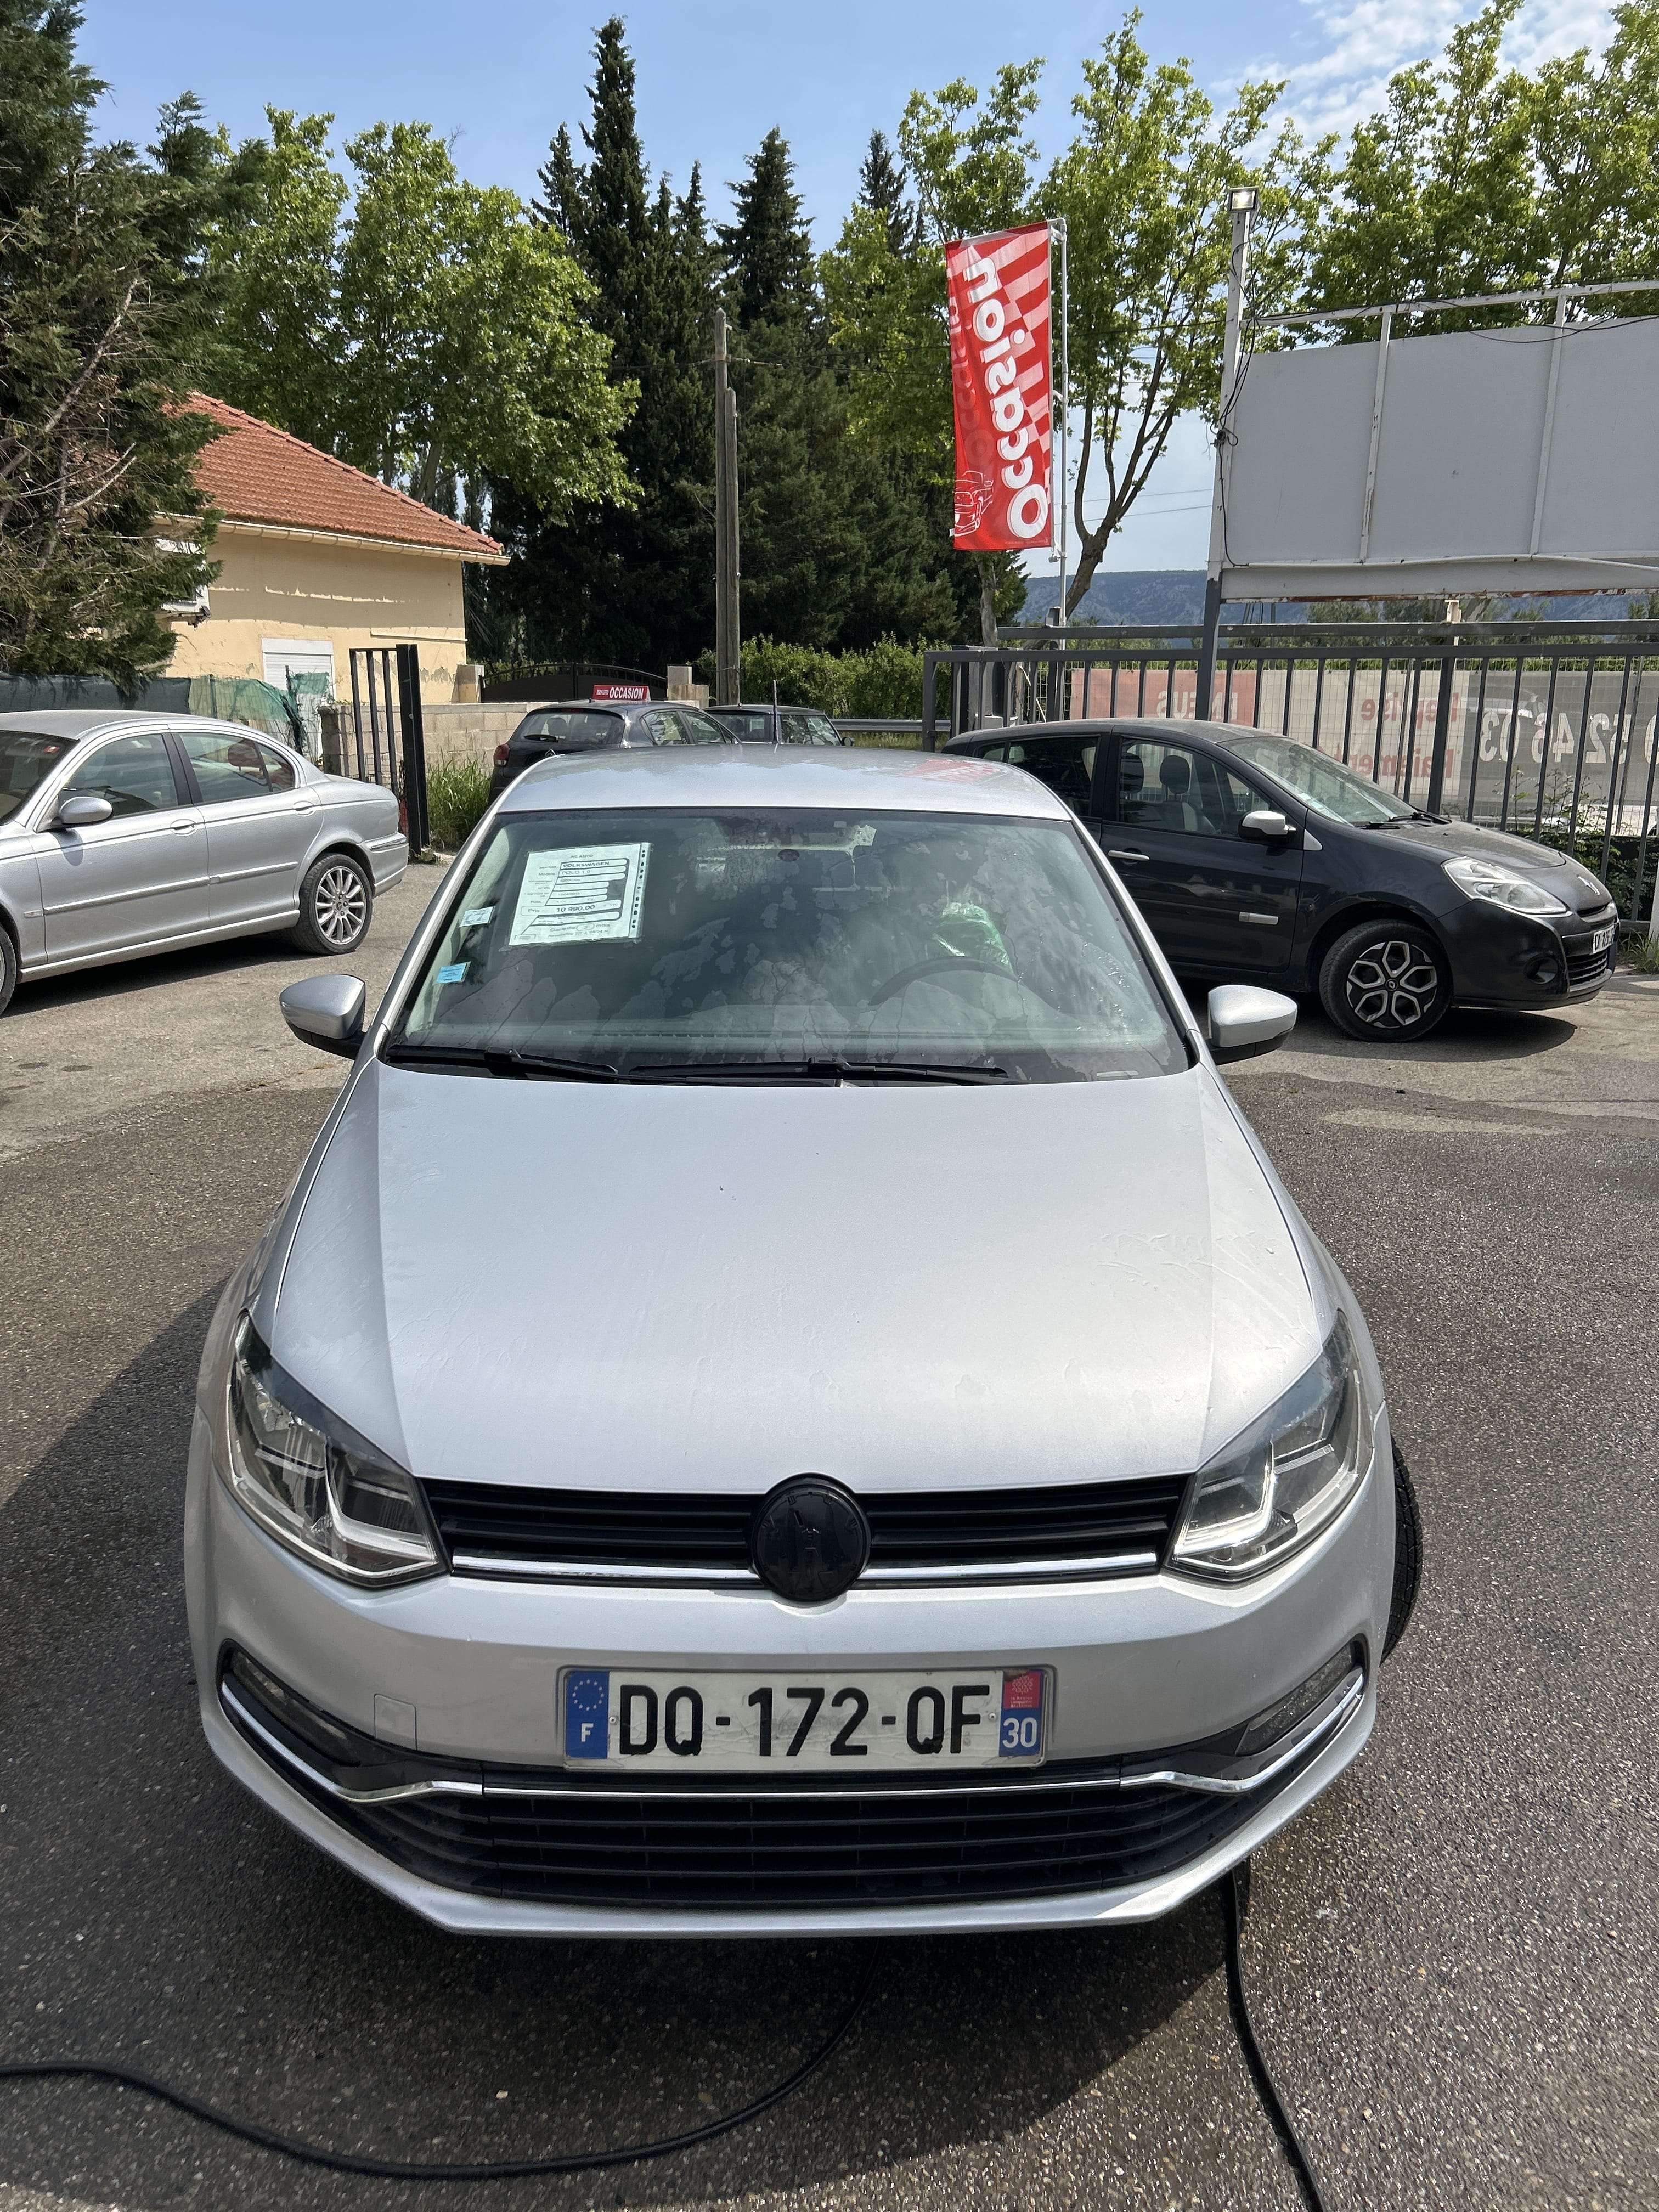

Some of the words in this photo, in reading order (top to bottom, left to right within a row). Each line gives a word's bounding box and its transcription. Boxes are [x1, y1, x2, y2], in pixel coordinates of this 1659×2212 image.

[609, 687, 644, 699] OCCASION
[582, 1723, 593, 1743] F
[619, 1684, 990, 1757] DQ-172-QF
[1002, 1717, 1037, 1748] 30
